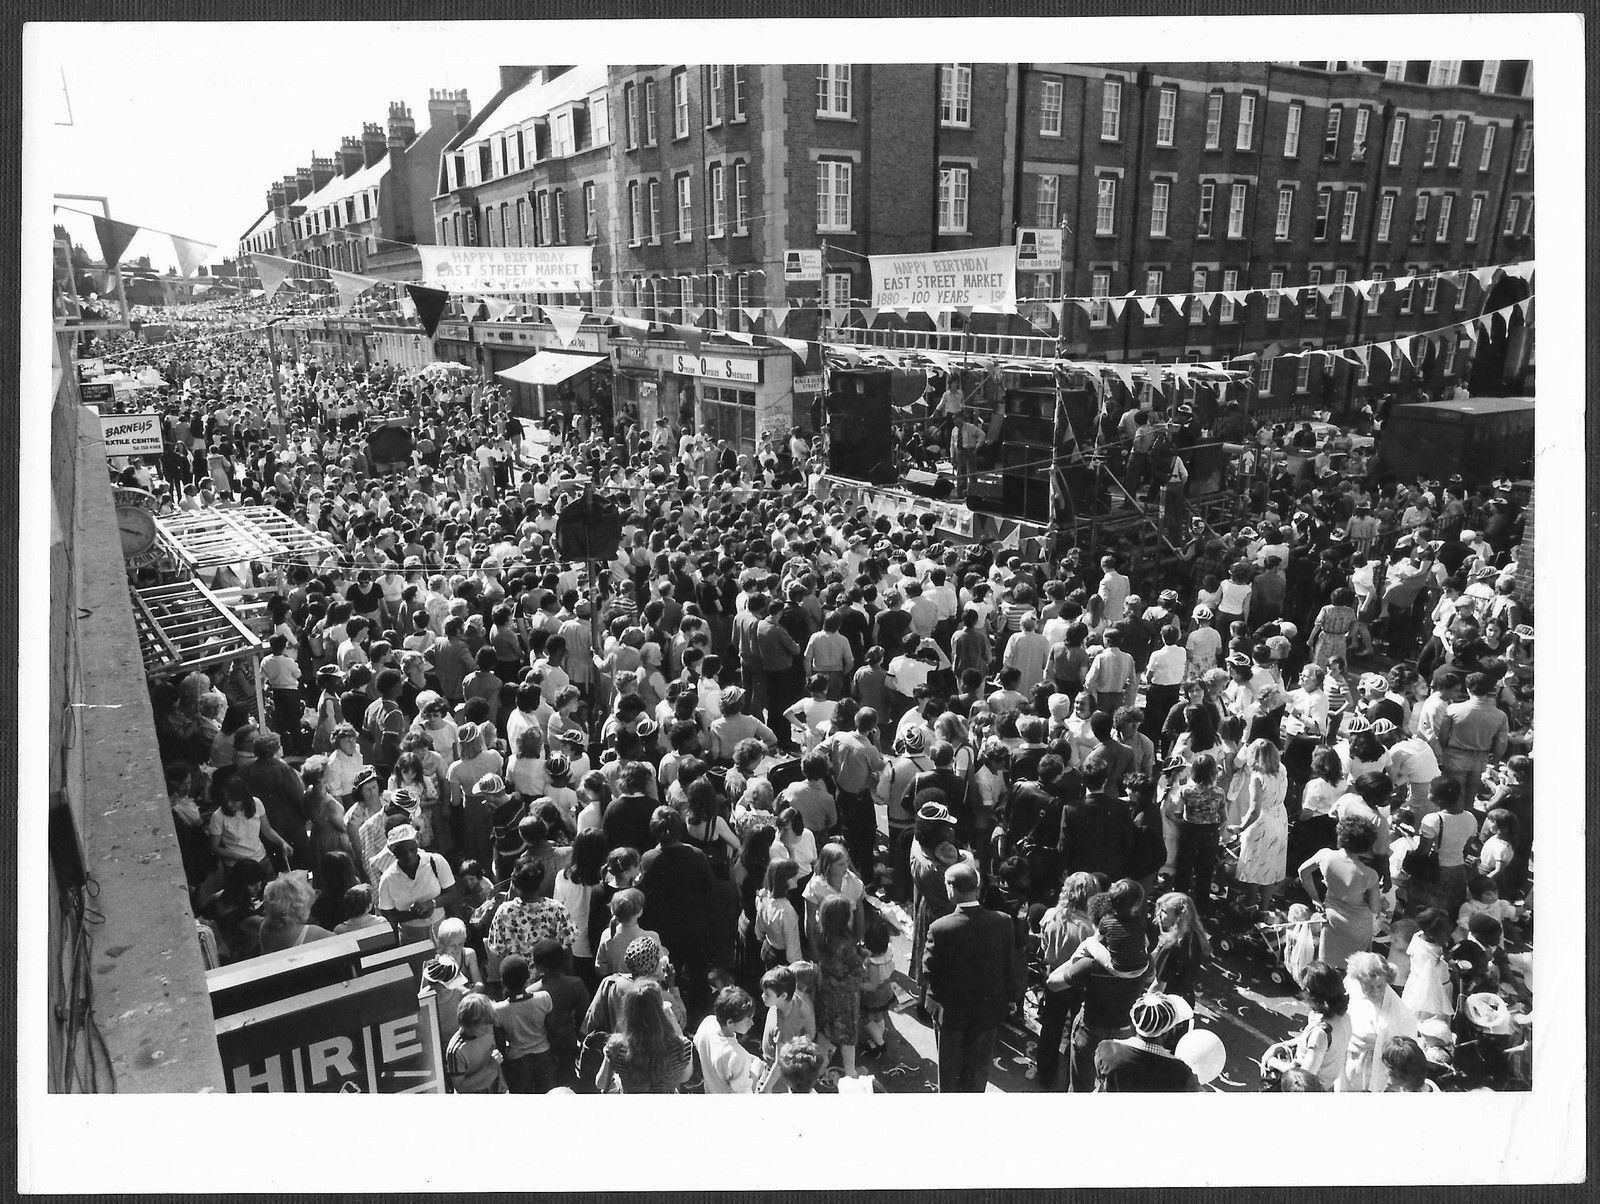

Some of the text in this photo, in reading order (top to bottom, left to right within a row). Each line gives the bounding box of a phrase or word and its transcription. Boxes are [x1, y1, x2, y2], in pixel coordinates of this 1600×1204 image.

[452, 252, 565, 264] HAPPY BIRTHDAY
[893, 257, 988, 275] HAPPY BIRTHDAY
[480, 264, 527, 275] STREET
[536, 264, 579, 275] MARKET
[883, 273, 1003, 290] EAST STREET MARKET
[877, 293, 900, 306] 1880
[912, 291, 930, 304] 100
[937, 290, 970, 304] YEARS
[105, 420, 153, 438] BARNEYS
